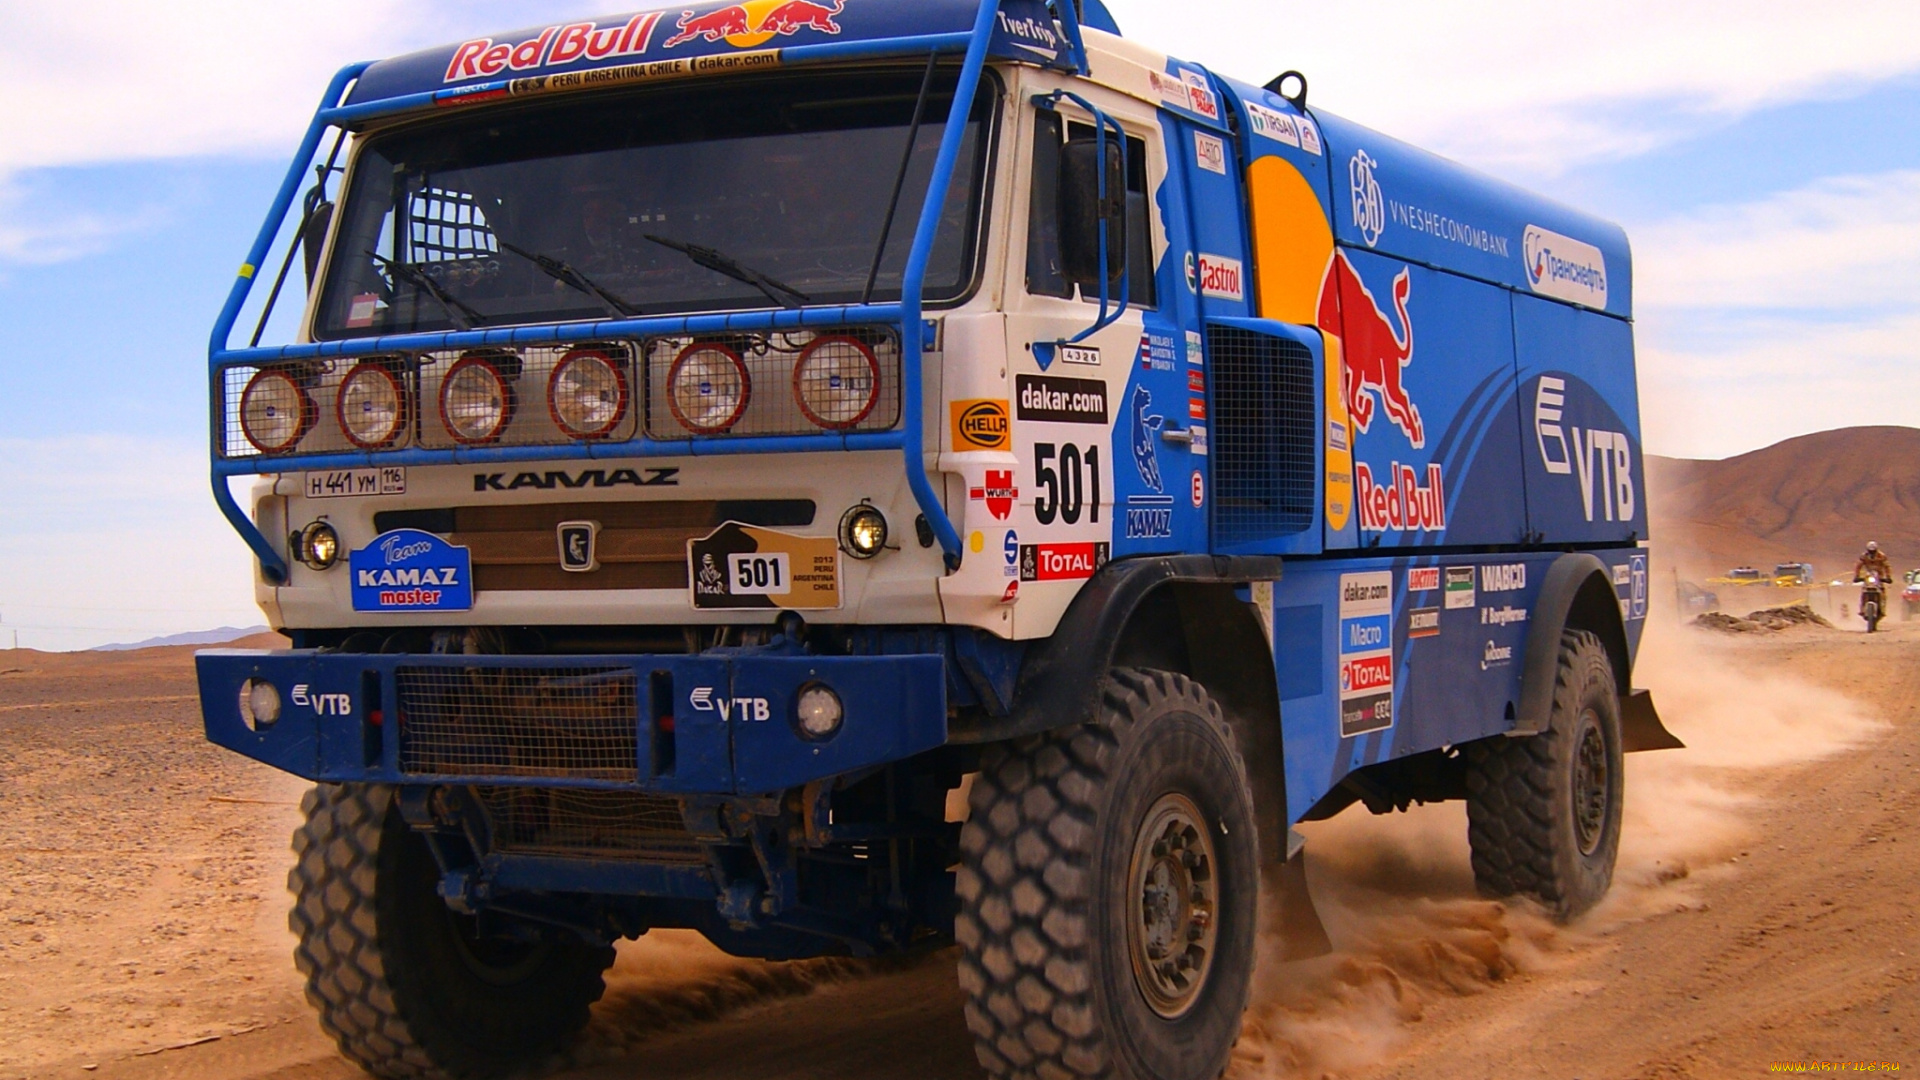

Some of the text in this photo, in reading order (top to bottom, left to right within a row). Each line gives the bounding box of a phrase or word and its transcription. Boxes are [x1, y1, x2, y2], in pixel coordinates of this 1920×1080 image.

[997, 11, 1056, 48] TverTrip
[444, 12, 665, 82] Red Bull
[699, 52, 775, 70] dakar.com
[552, 60, 682, 88] PERU ARGENTINA CHILE
[1389, 200, 1509, 258] VNESHECONOMBANK
[1199, 258, 1241, 294] Castrol
[1543, 248, 1605, 294] Транснефть
[1022, 383, 1103, 413] dakar.com
[966, 417, 1008, 433] HELLA
[326, 472, 352, 493] 441
[383, 468, 401, 483] 116
[474, 467, 680, 491] KAMAZ
[1034, 442, 1100, 525] 501
[1572, 427, 1634, 522] VTB
[1355, 461, 1446, 532] Red Bull
[1126, 509, 1172, 538] KAMAZ
[381, 535, 432, 565] Team
[358, 568, 459, 587] KAMAZ
[738, 558, 780, 587] 501
[1481, 563, 1526, 592] WABCO
[380, 587, 441, 605] master
[1344, 582, 1388, 602] dakar.com
[1350, 624, 1381, 646] Macro
[311, 694, 351, 715] VTB
[716, 697, 770, 721] VTB
